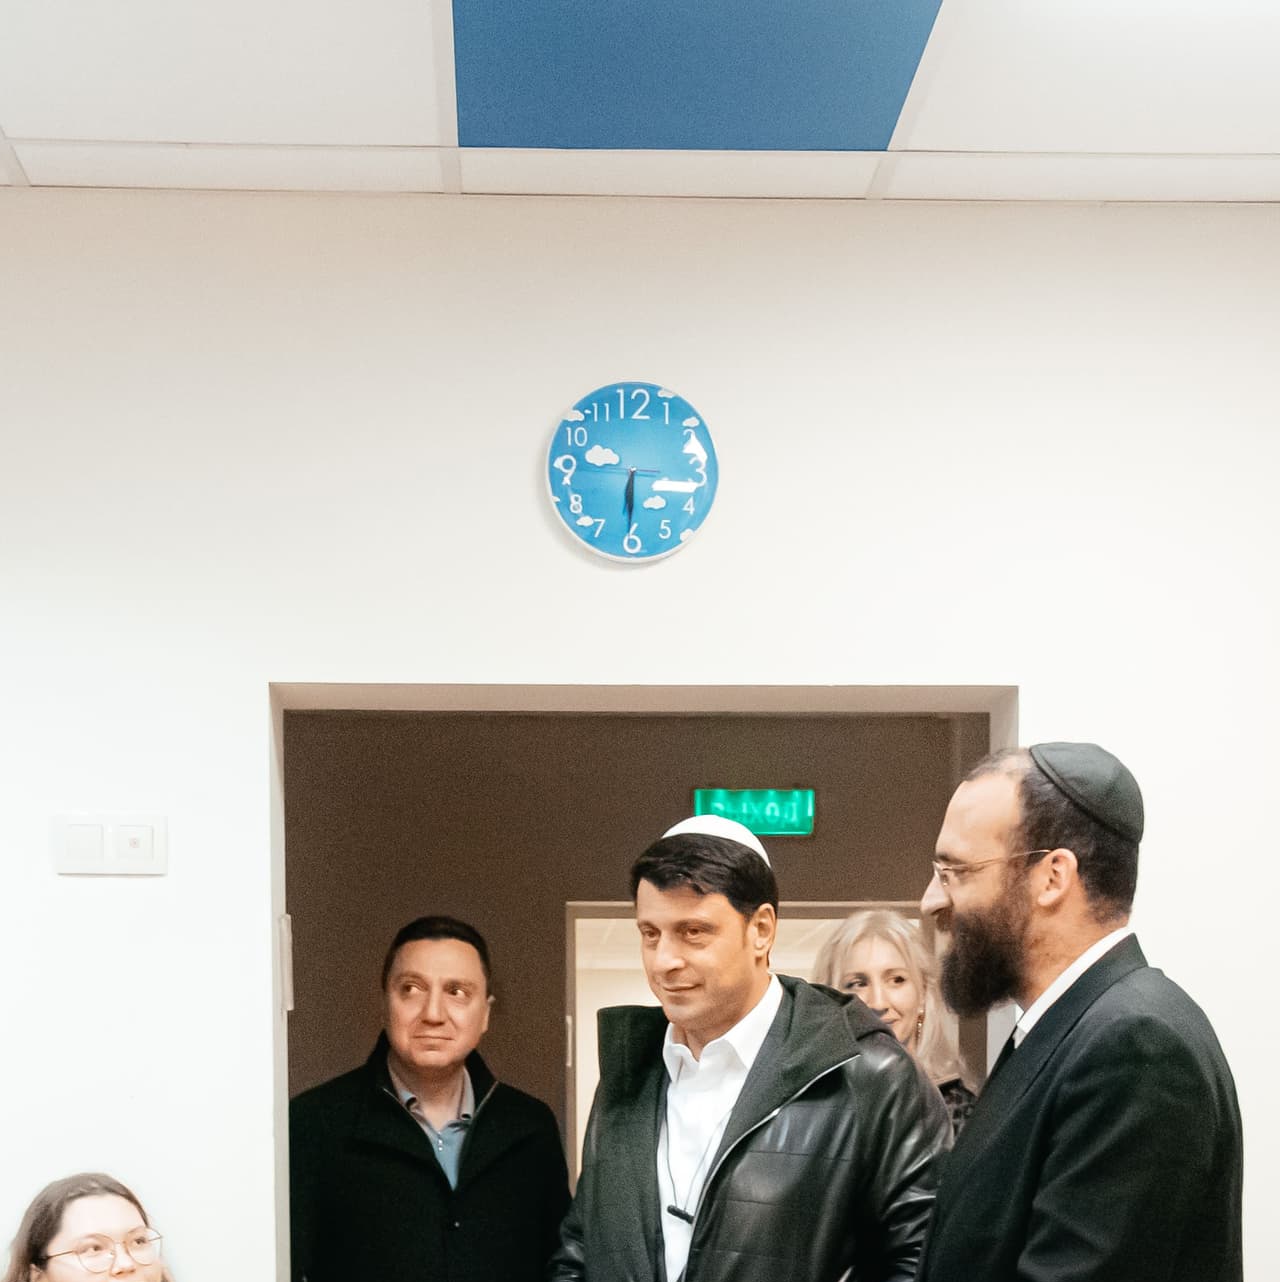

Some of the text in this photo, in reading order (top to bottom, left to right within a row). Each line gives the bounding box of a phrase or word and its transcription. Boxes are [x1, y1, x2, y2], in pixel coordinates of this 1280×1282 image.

[592, 402, 610, 422] 11
[616, 388, 651, 420] 12
[663, 402, 670, 425] 1
[566, 426, 588, 447] 10
[559, 454, 577, 485] 9
[689, 457, 707, 488] 3
[570, 494, 583, 513] 8
[683, 496, 695, 515] 4
[593, 519, 606, 538] 7
[622, 522, 642, 554] 6
[658, 519, 672, 540] 5
